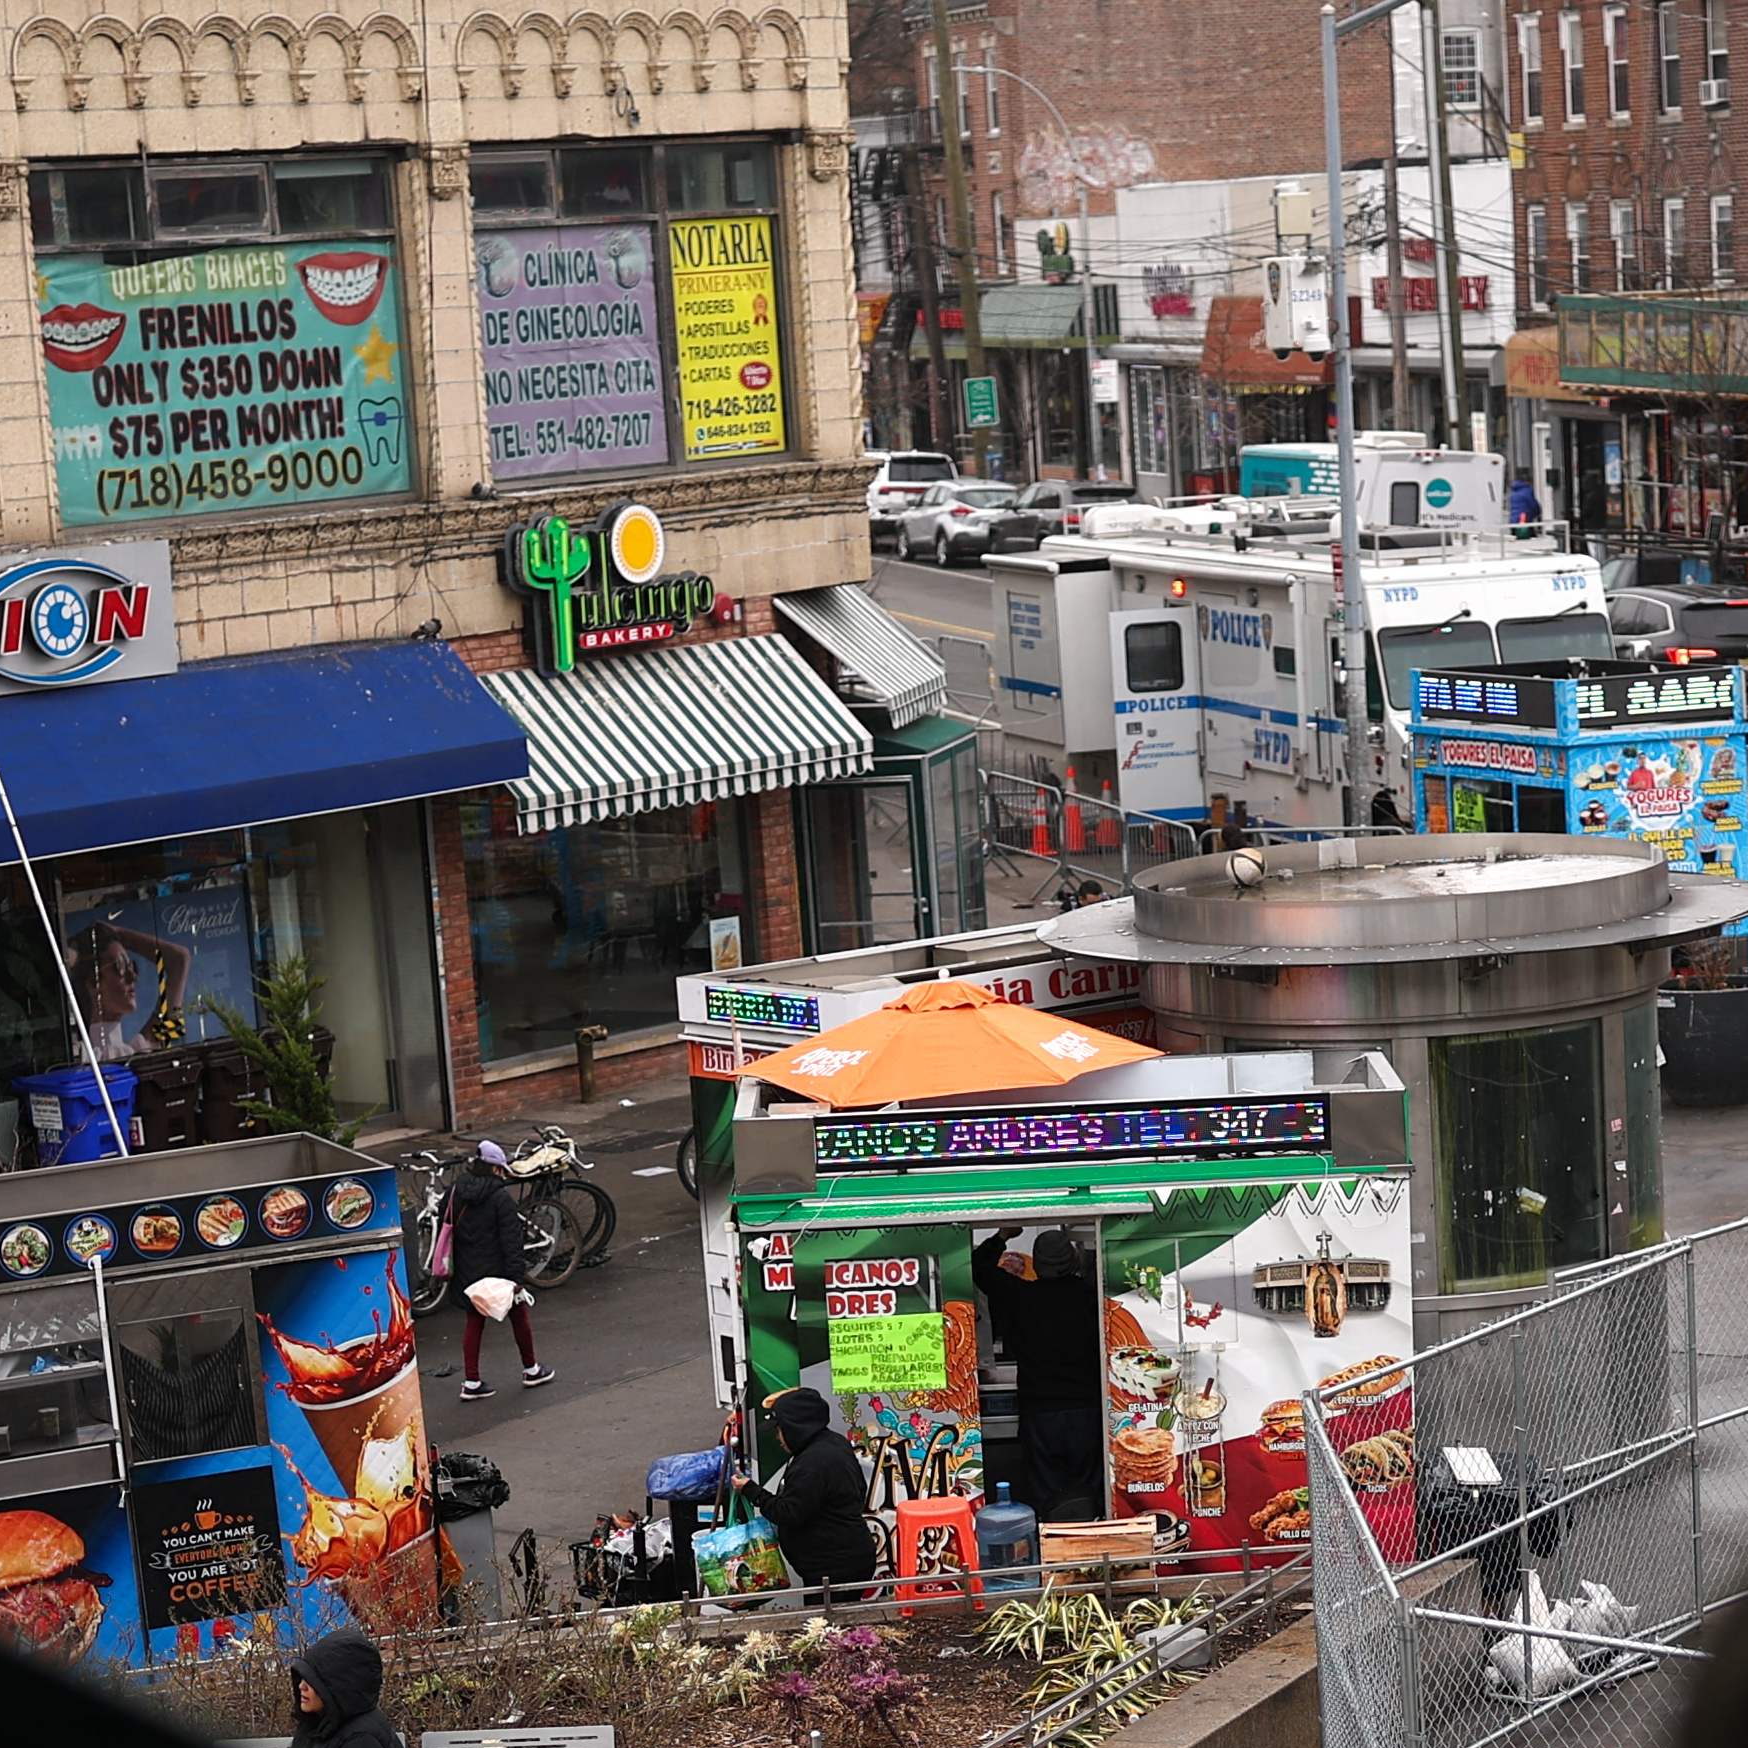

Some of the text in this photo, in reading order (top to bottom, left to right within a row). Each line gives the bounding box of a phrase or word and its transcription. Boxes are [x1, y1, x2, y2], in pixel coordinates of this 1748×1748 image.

[671, 222, 769, 269] NOTARIA
[111, 251, 286, 300] QUEENS BRACES
[524, 244, 599, 288] CLÍNICA
[677, 273, 768, 296] PRIMERA-NY
[685, 299, 734, 315] PODERES
[138, 298, 297, 351] FRENILLOS
[485, 295, 643, 346] DE GINECOLOGÍA
[686, 320, 750, 339] APOSTILLAS
[688, 341, 769, 361] TRADUCCIONES
[92, 345, 343, 407] ONLY $350 DOWN
[486, 359, 656, 407] NO NECESITA CITA
[689, 366, 731, 383] CARTAS
[109, 397, 345, 459] $75 PER MONTH!
[490, 413, 652, 461] TEL: 551-482-7207
[96, 445, 364, 516] (718)458-9000
[1384, 587, 1419, 602] NYPD
[1552, 576, 1586, 591] NYPD
[585, 625, 667, 647] BAKERY
[1211, 609, 1261, 648] POLICE
[1126, 696, 1188, 713] POLICE
[1254, 728, 1291, 765] NYPD
[1441, 741, 1487, 766] YOGURES
[1504, 745, 1535, 770] PAISA
[1627, 788, 1693, 807] YOGURES
[794, 1046, 870, 1068] APEROL
[950, 1119, 1103, 1151] ANDRES
[1128, 1403, 1164, 1413] GELATINA
[1203, 1421, 1219, 1431] CON
[1128, 1482, 1165, 1493] BUÑUELOS
[163, 1525, 255, 1549] YOU CAN'T MAKE
[1280, 1530, 1299, 1539] POLLO
[168, 1569, 197, 1583] YOU
[201, 1564, 227, 1578] ARE
